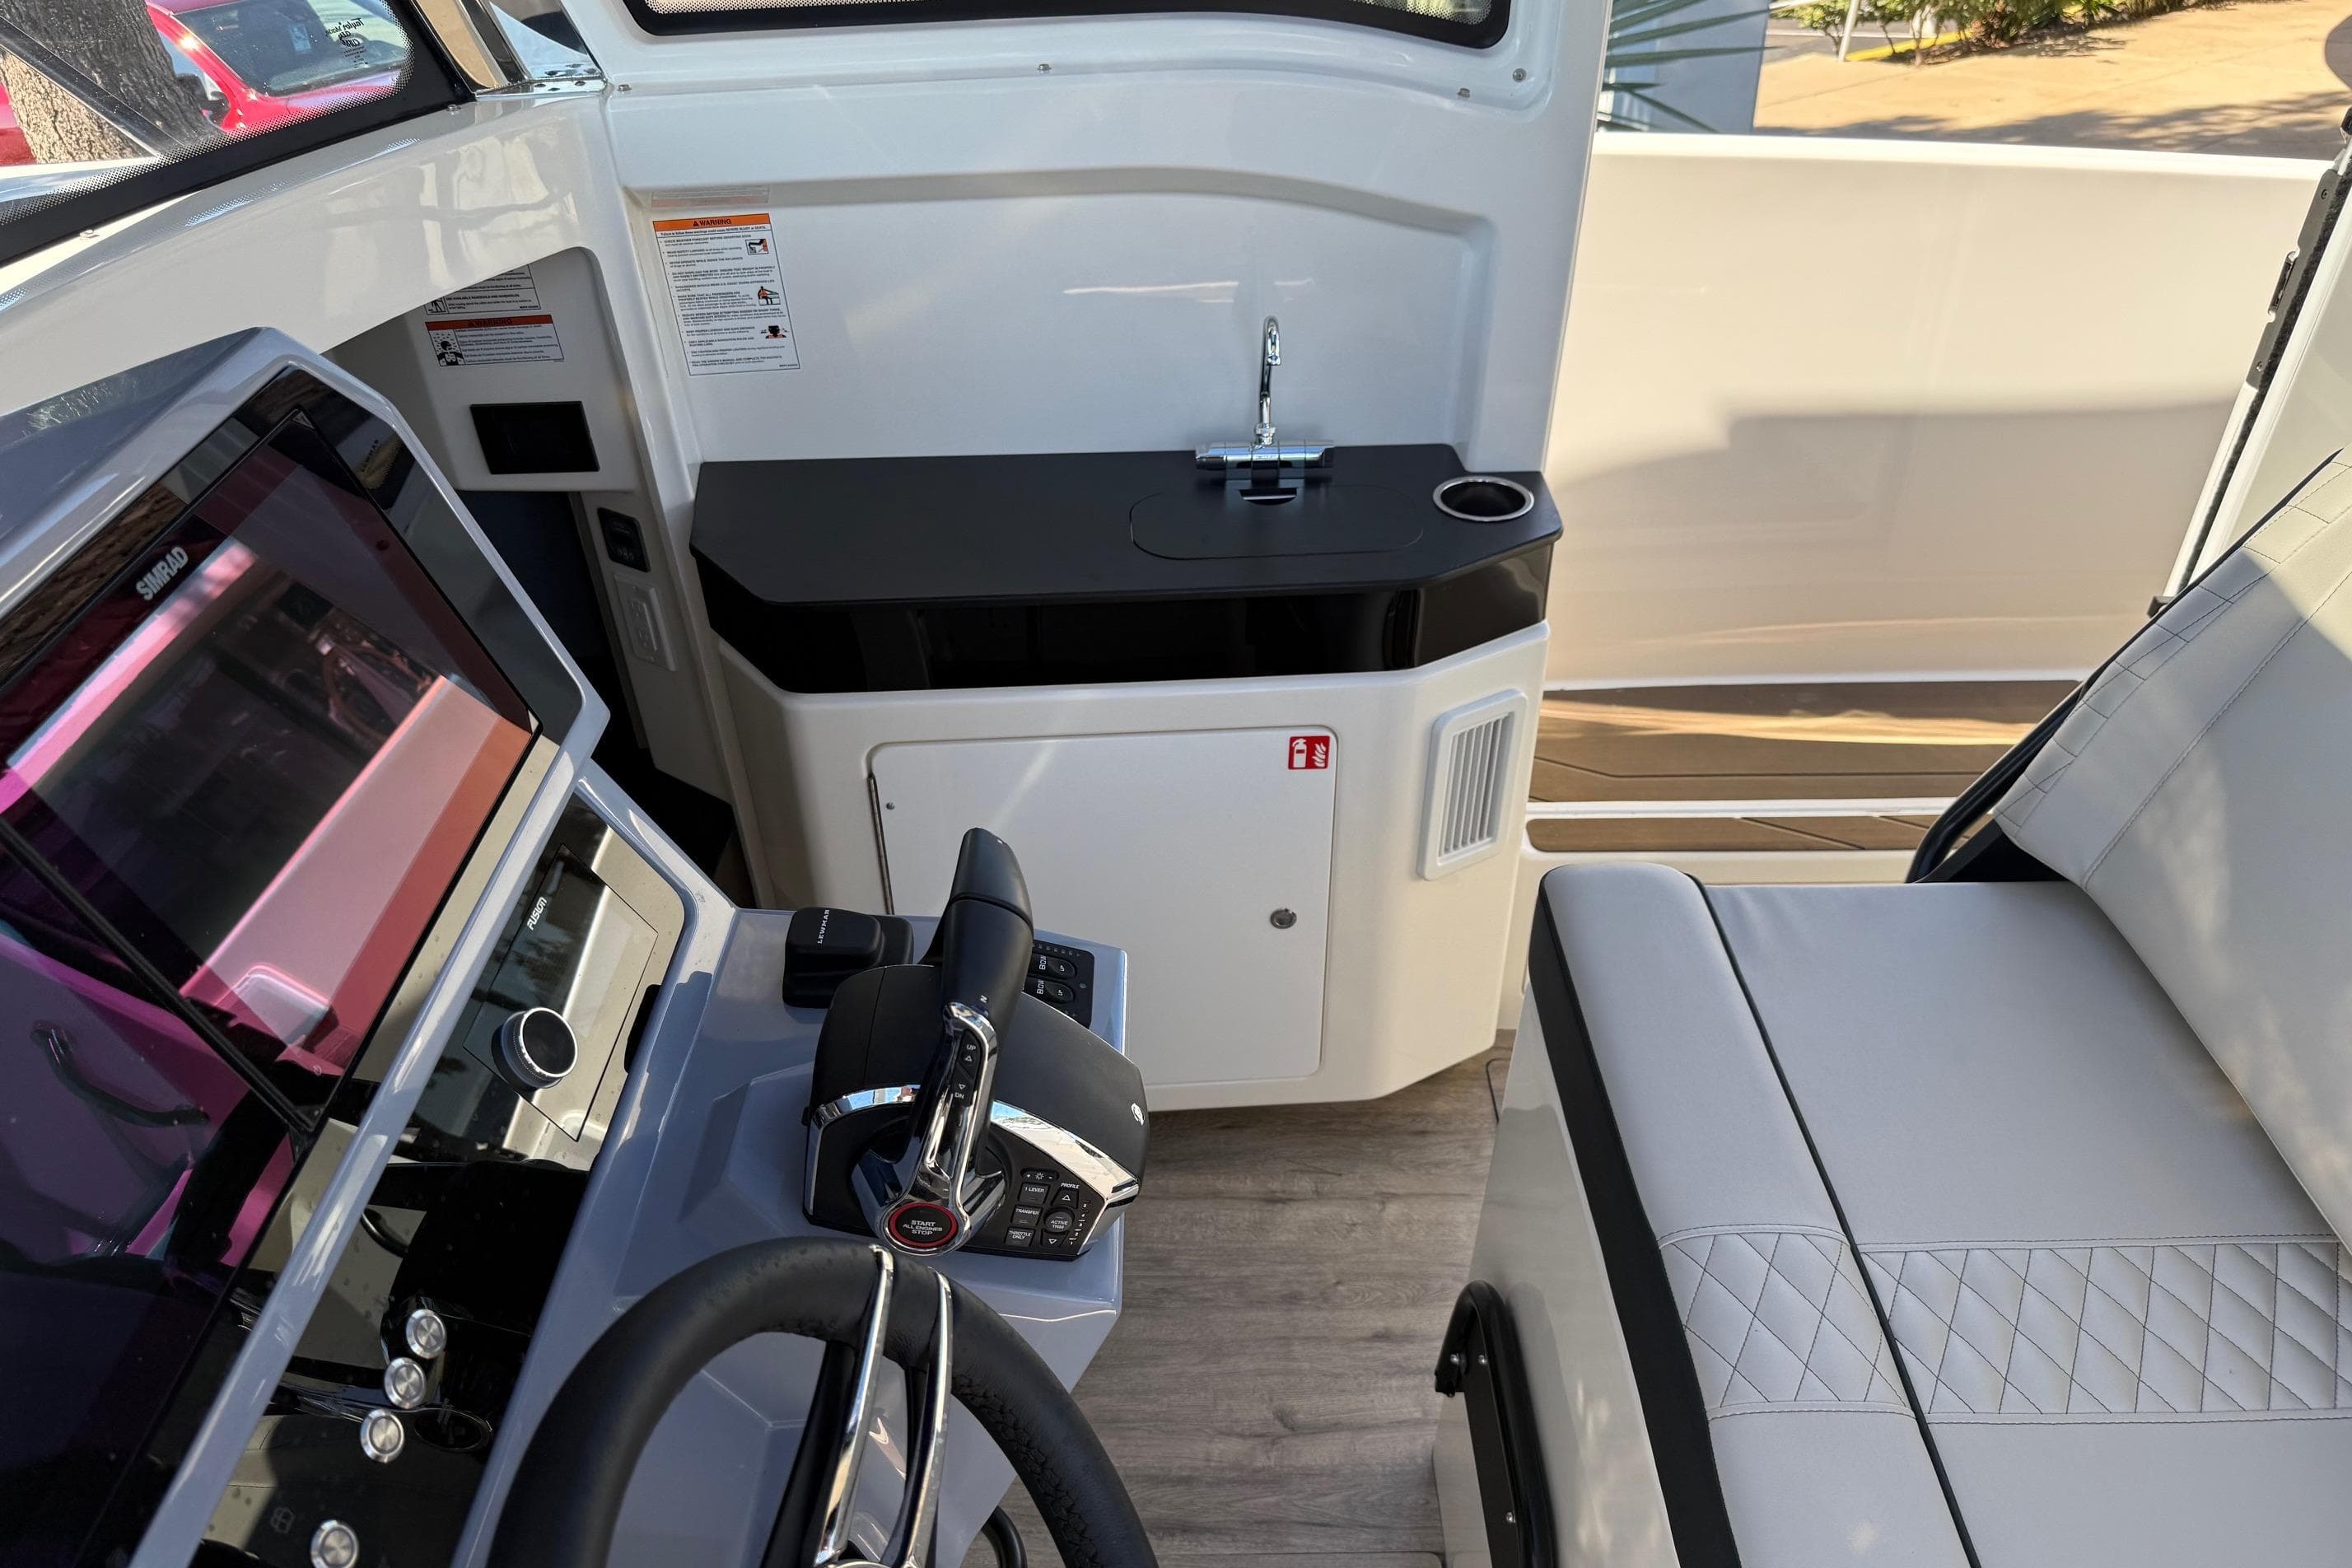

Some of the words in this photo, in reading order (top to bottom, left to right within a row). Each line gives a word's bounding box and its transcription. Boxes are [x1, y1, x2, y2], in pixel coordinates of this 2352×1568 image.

[699, 218, 732, 226] WARNING
[136, 546, 189, 600] SIMRAD
[527, 896, 548, 931] FUSION
[980, 994, 988, 1003] N
[966, 1043, 977, 1052] UP
[1015, 1207, 1039, 1216] TRANSFER
